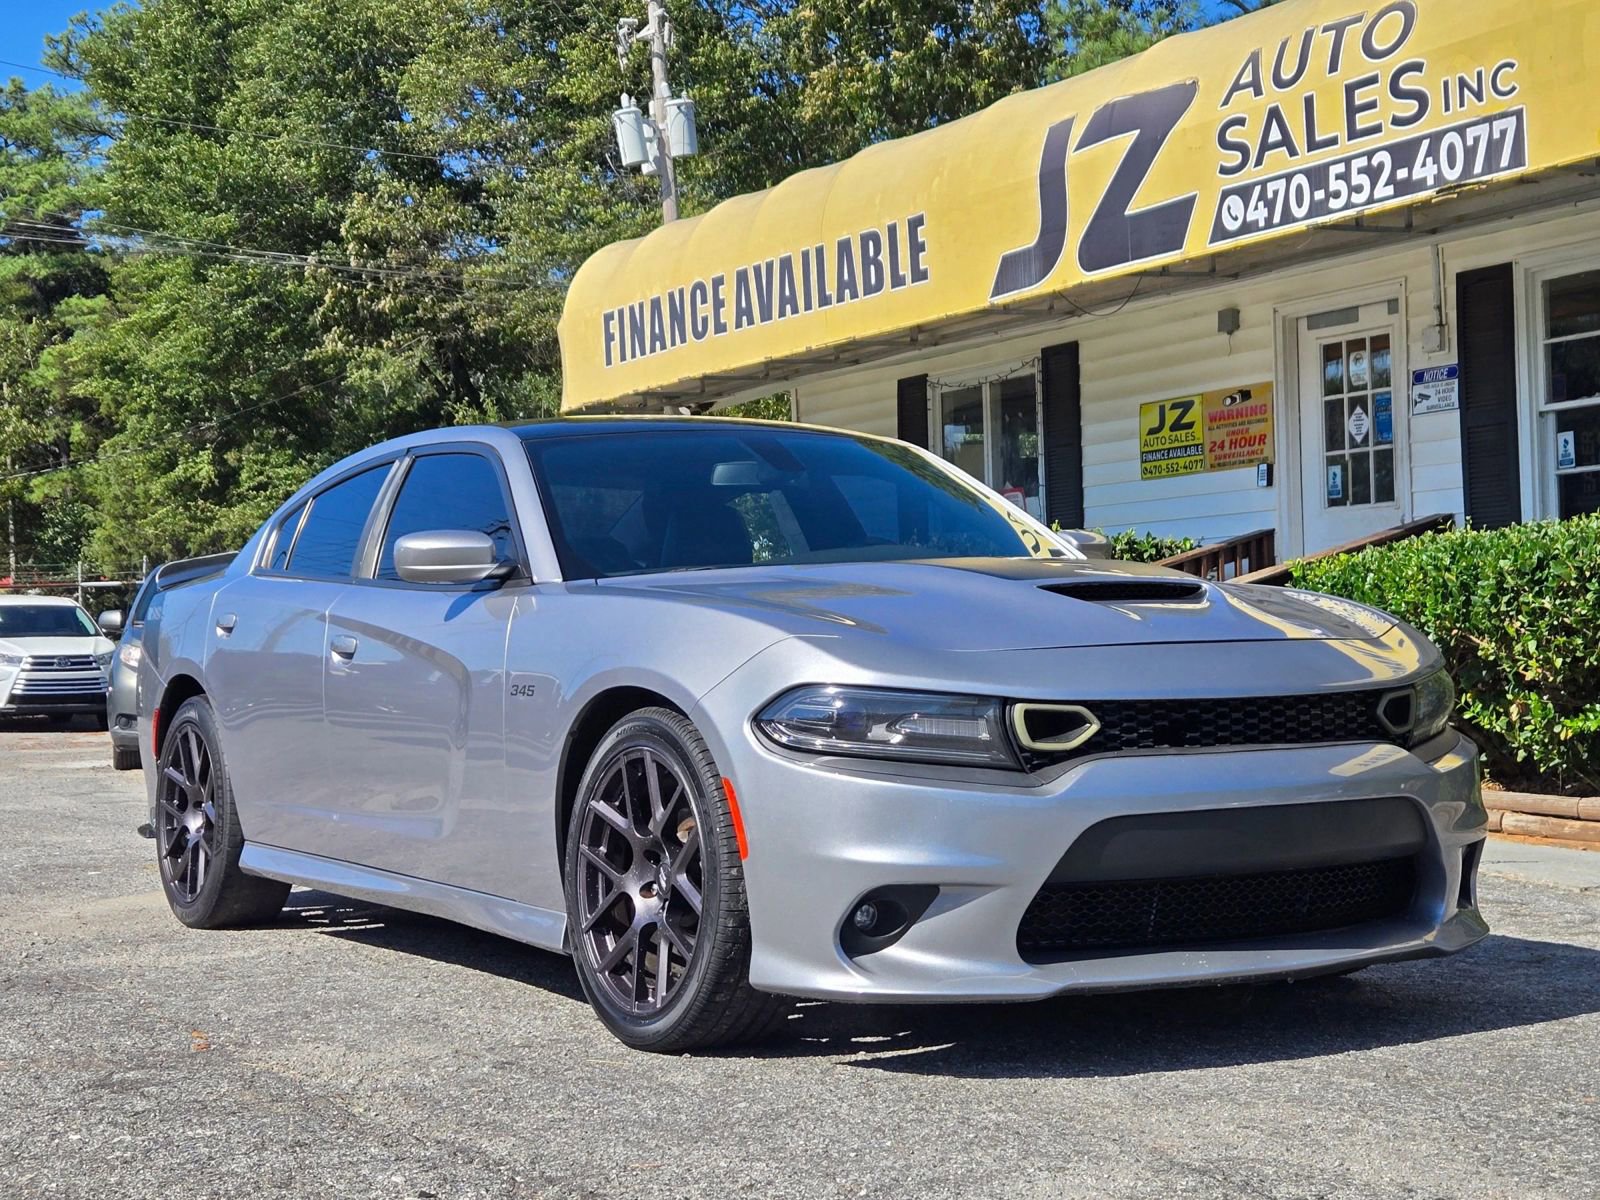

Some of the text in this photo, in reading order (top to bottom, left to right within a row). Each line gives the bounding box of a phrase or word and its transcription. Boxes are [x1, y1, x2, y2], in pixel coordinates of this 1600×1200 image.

[1219, 1, 1417, 108] AUTO
[1216, 59, 1519, 176] SALES INC
[1246, 116, 1518, 228] 470-552-4077
[989, 78, 1199, 299] JZ
[602, 211, 930, 368] FINANCE AVAILABLE
[1423, 367, 1449, 382] NOTICE
[1146, 400, 1196, 436] JZ
[1208, 404, 1268, 424] WARNING
[1143, 431, 1196, 449] AUTO SALES
[1226, 427, 1250, 437] UNDER
[1209, 433, 1267, 453] 24 HOUR
[1142, 445, 1203, 462] FINANCE AVAILABLE
[1214, 448, 1265, 462] SURVEILLANCE
[1148, 459, 1204, 475] 470-552-4077
[510, 684, 536, 697] 345
